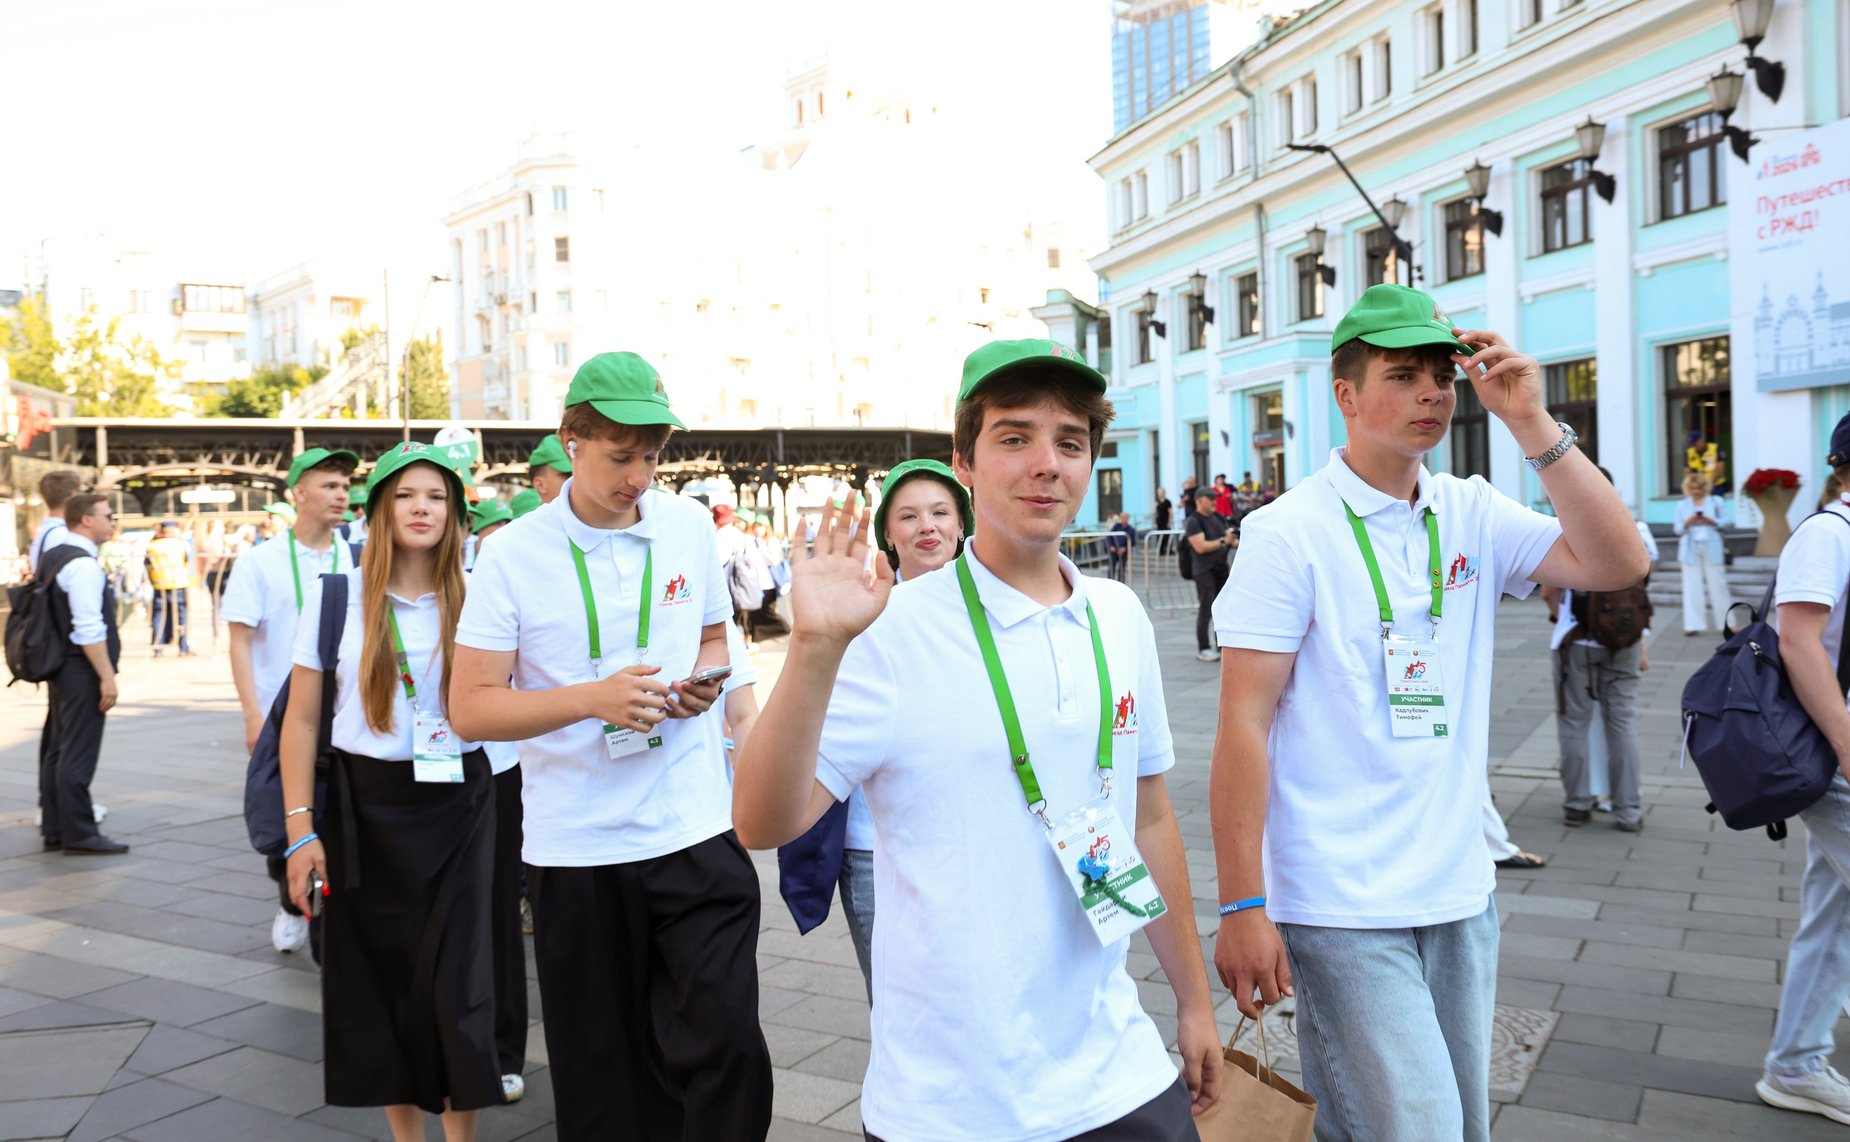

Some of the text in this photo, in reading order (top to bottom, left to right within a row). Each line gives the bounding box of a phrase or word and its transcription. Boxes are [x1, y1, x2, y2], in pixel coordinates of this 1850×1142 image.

[1757, 178, 1850, 215] Путешест
[1757, 208, 1819, 239] с РЖД!
[447, 443, 472, 459] 4.1
[1094, 873, 1133, 900] УТНИК
[1098, 910, 1119, 925] Артем
